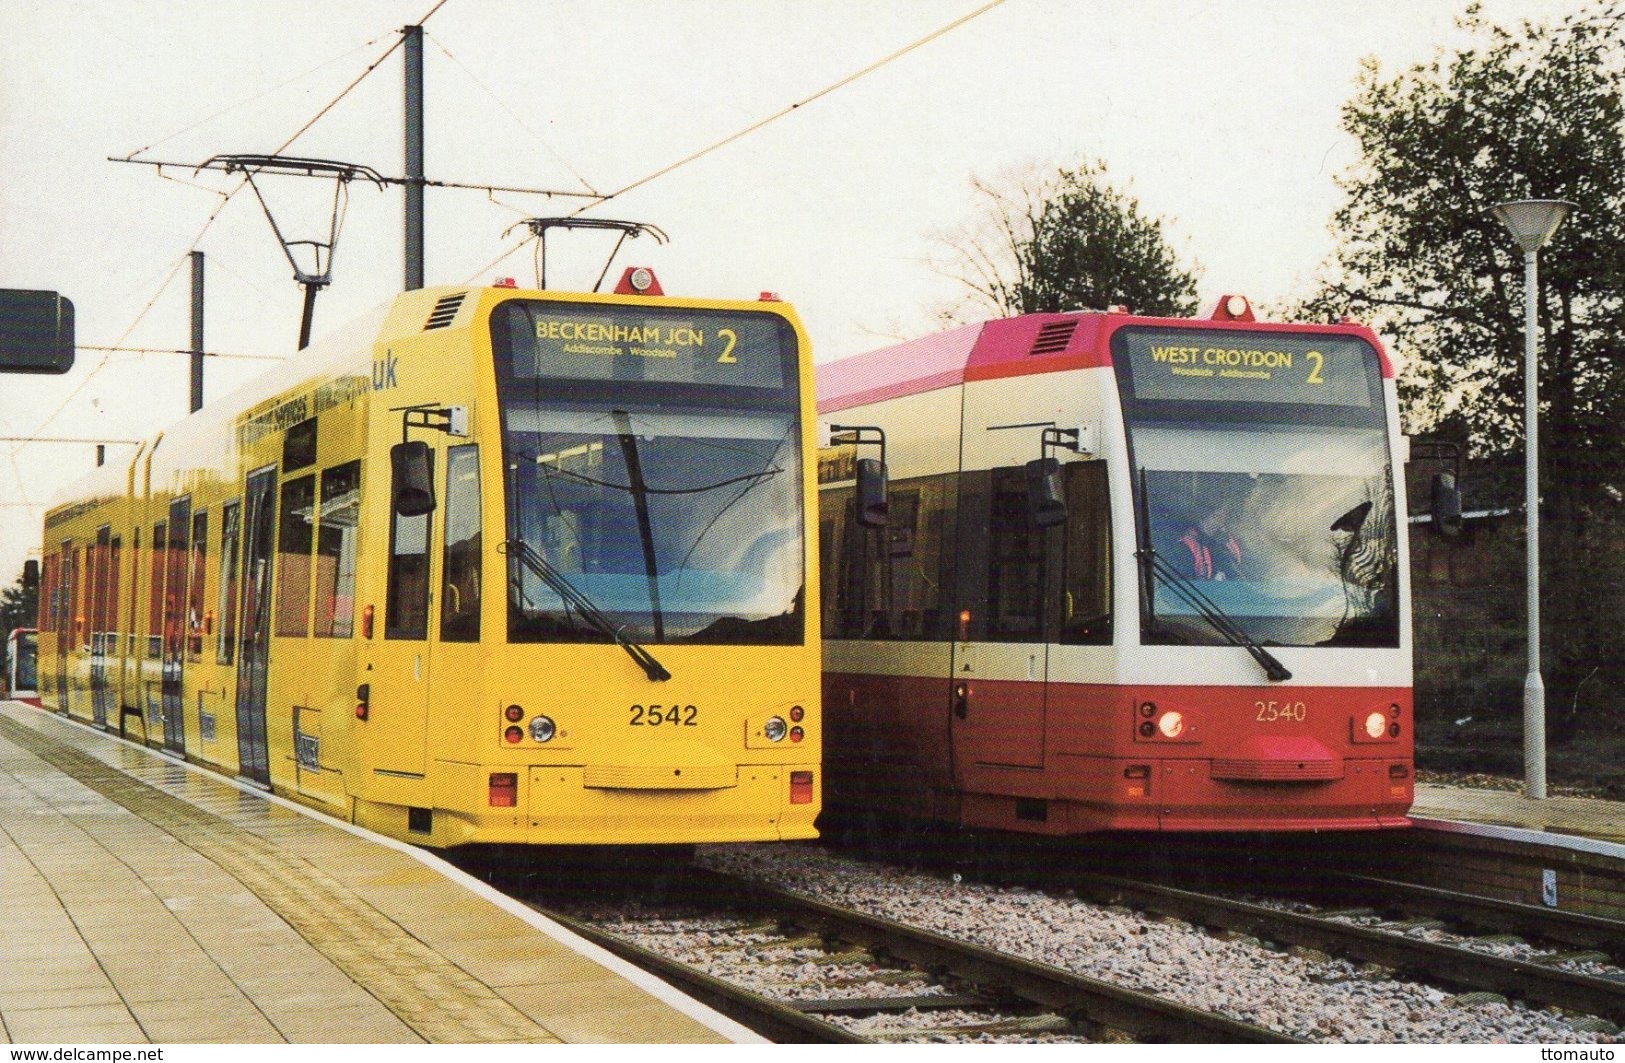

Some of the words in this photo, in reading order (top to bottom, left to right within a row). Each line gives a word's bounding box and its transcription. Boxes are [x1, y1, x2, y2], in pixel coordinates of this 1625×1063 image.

[536, 322, 659, 343] BECKENHAM
[664, 327, 703, 347] JCN
[717, 328, 738, 364] 2
[1152, 347, 1198, 364] WEST
[1203, 349, 1292, 367] CROYDON
[1305, 351, 1324, 384] 2
[629, 704, 698, 727] 2542
[1255, 701, 1306, 722] 2540
